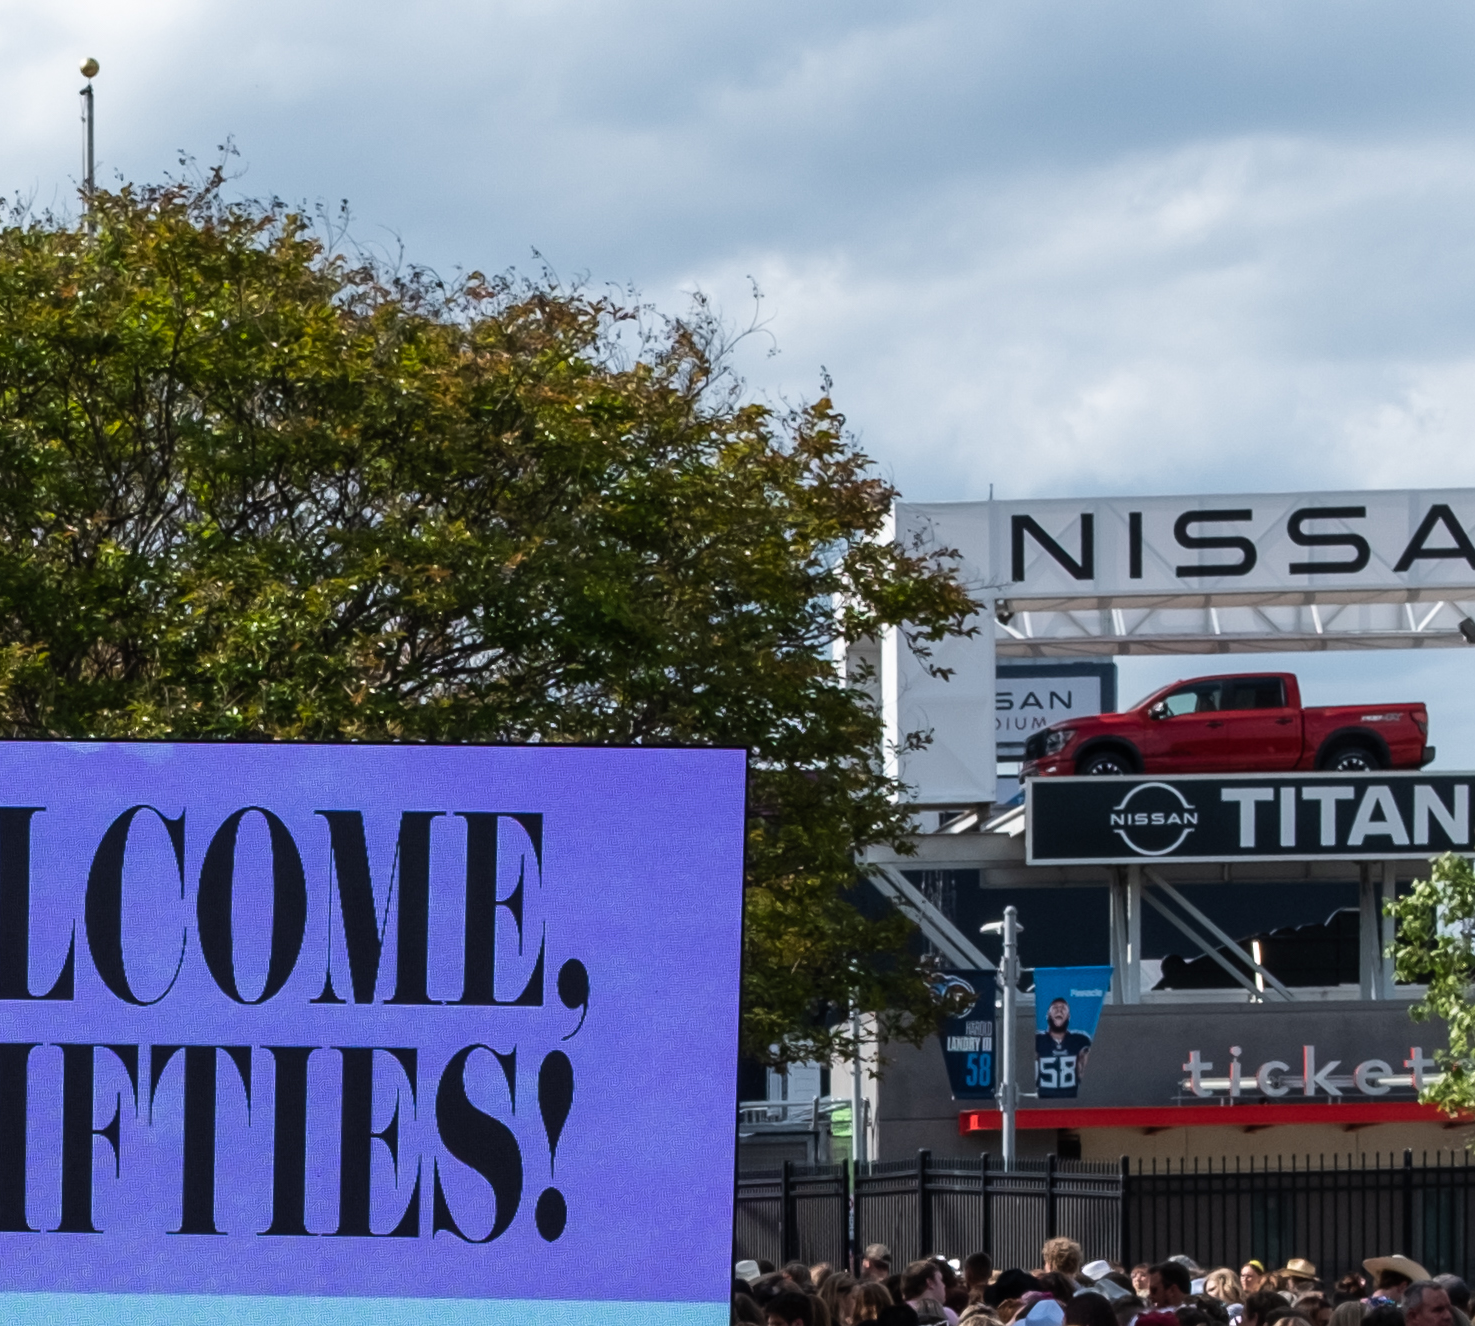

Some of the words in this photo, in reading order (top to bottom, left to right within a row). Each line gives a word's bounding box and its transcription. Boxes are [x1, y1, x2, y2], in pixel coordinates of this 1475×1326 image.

[995, 691, 1072, 711] SAN
[1111, 812, 1198, 827] NISSAN
[1222, 784, 1470, 848] TITAN
[965, 1021, 993, 1037] HAROLD
[947, 1037, 981, 1051] LANDRY
[966, 1053, 992, 1087] 58
[1039, 1056, 1078, 1089] 58
